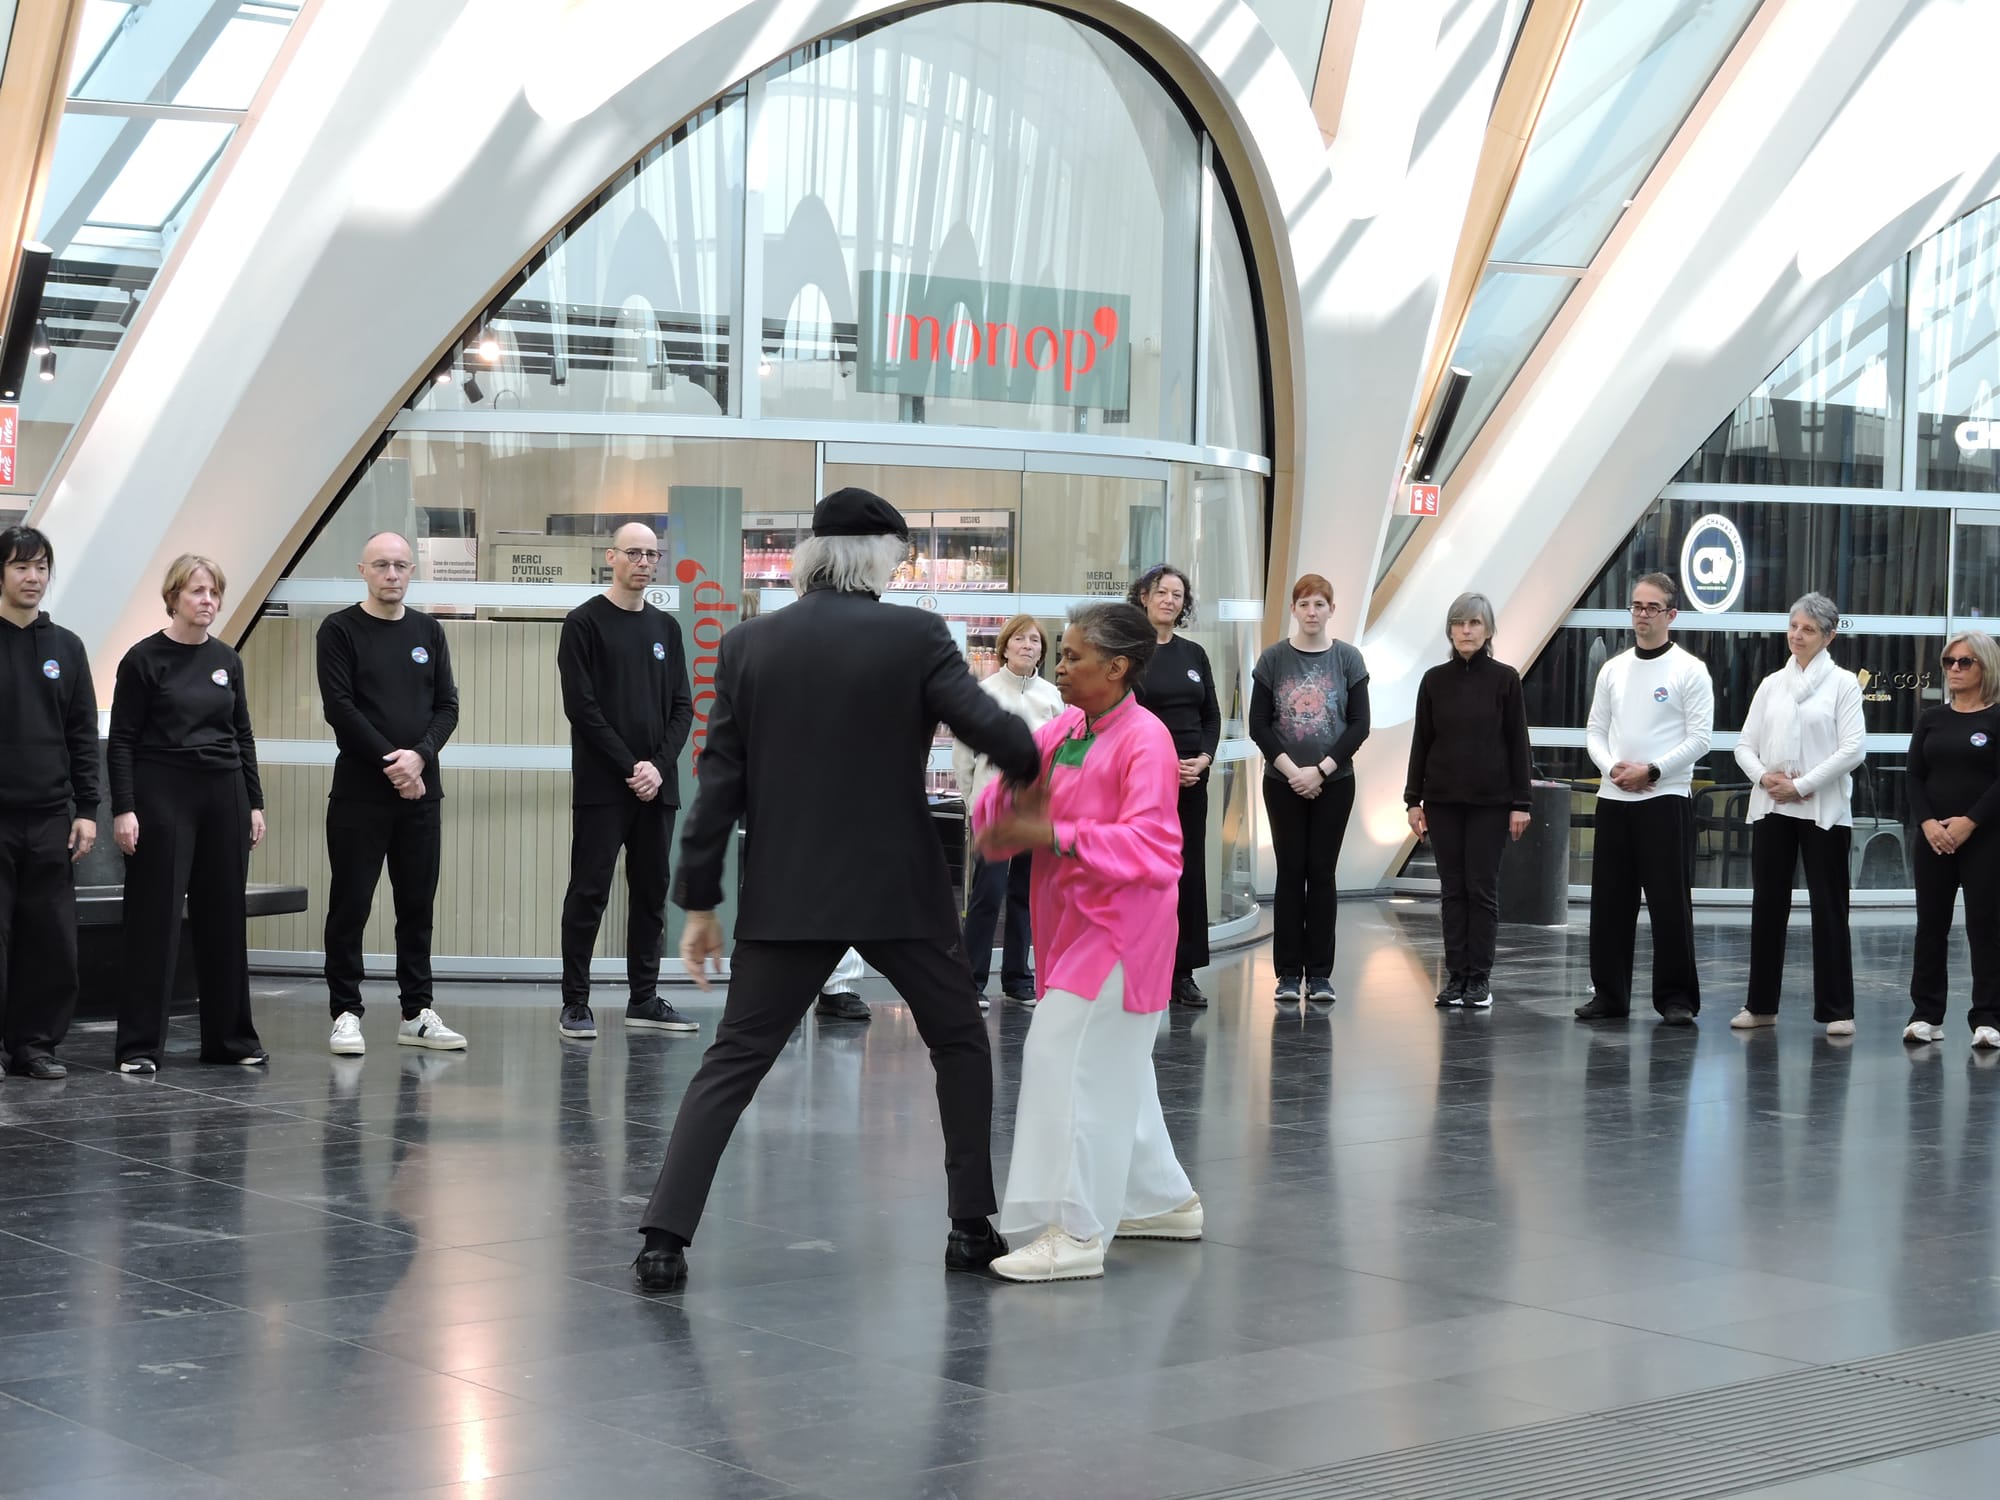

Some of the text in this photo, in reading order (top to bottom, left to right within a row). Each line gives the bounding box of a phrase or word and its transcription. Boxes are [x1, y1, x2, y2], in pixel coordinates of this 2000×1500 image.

[886, 306, 1118, 392] monop'
[512, 554, 541, 564] MERCI
[512, 565, 563, 576] D'UTILISER
[1087, 571, 1112, 580] MERCI
